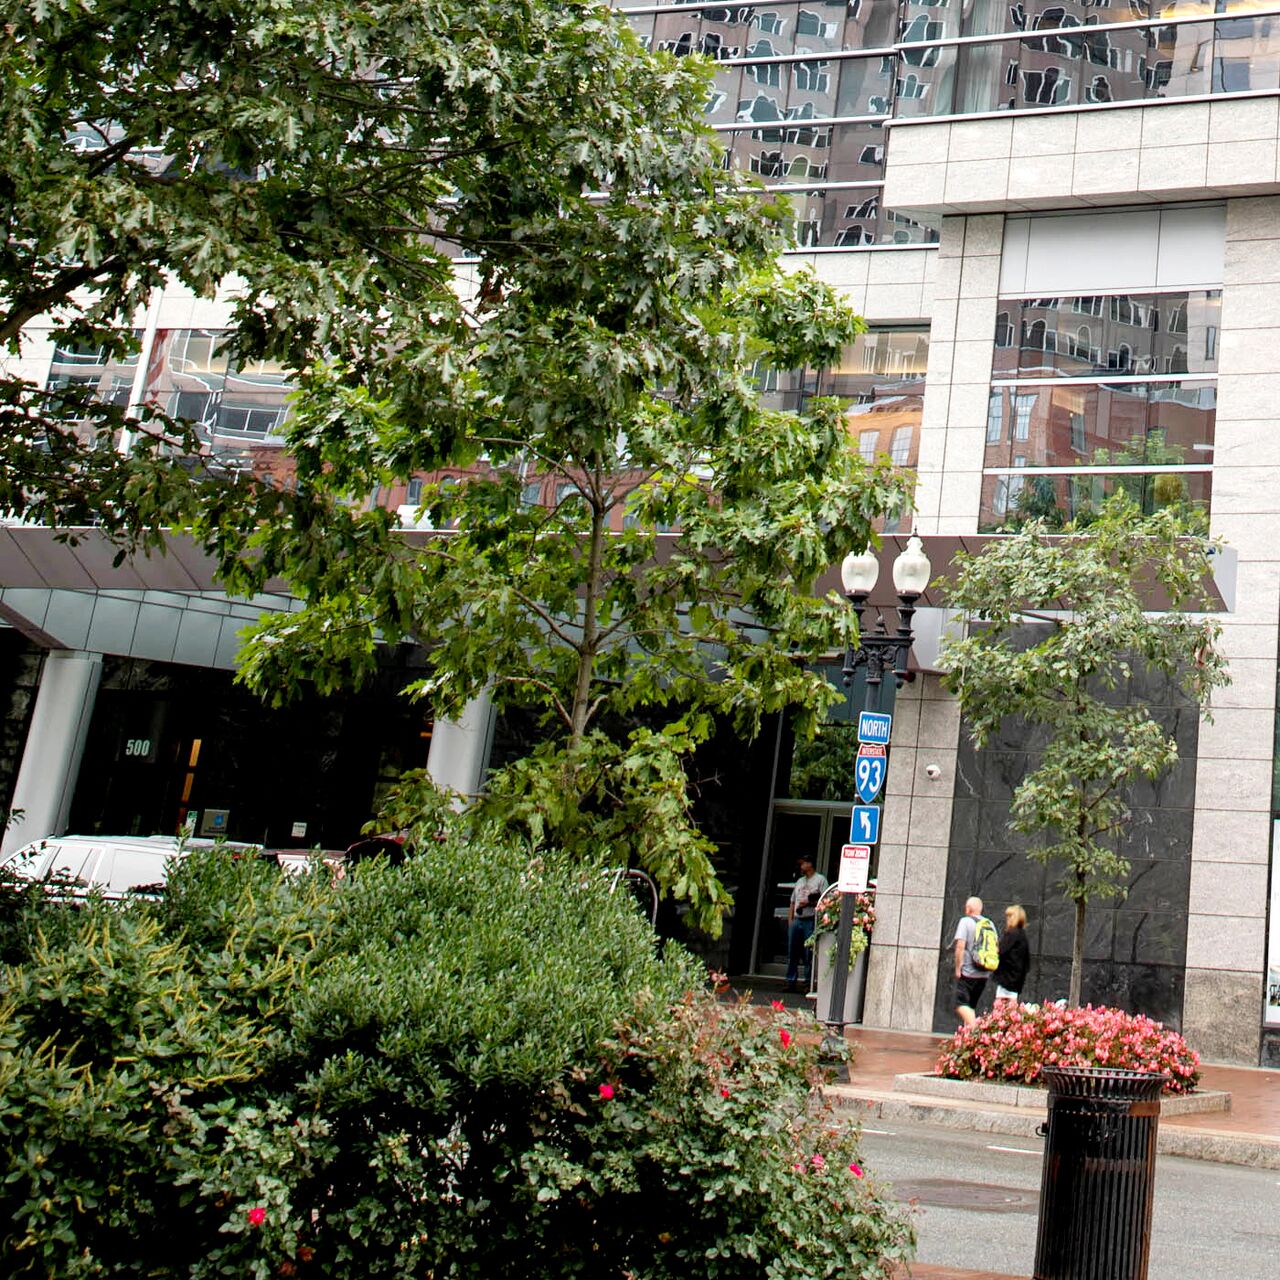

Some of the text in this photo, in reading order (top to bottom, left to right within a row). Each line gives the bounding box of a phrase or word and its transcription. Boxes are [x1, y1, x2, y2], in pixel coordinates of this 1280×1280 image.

[861, 719, 888, 738] NORTH
[125, 739, 150, 756] 500
[858, 759, 881, 793] 93
